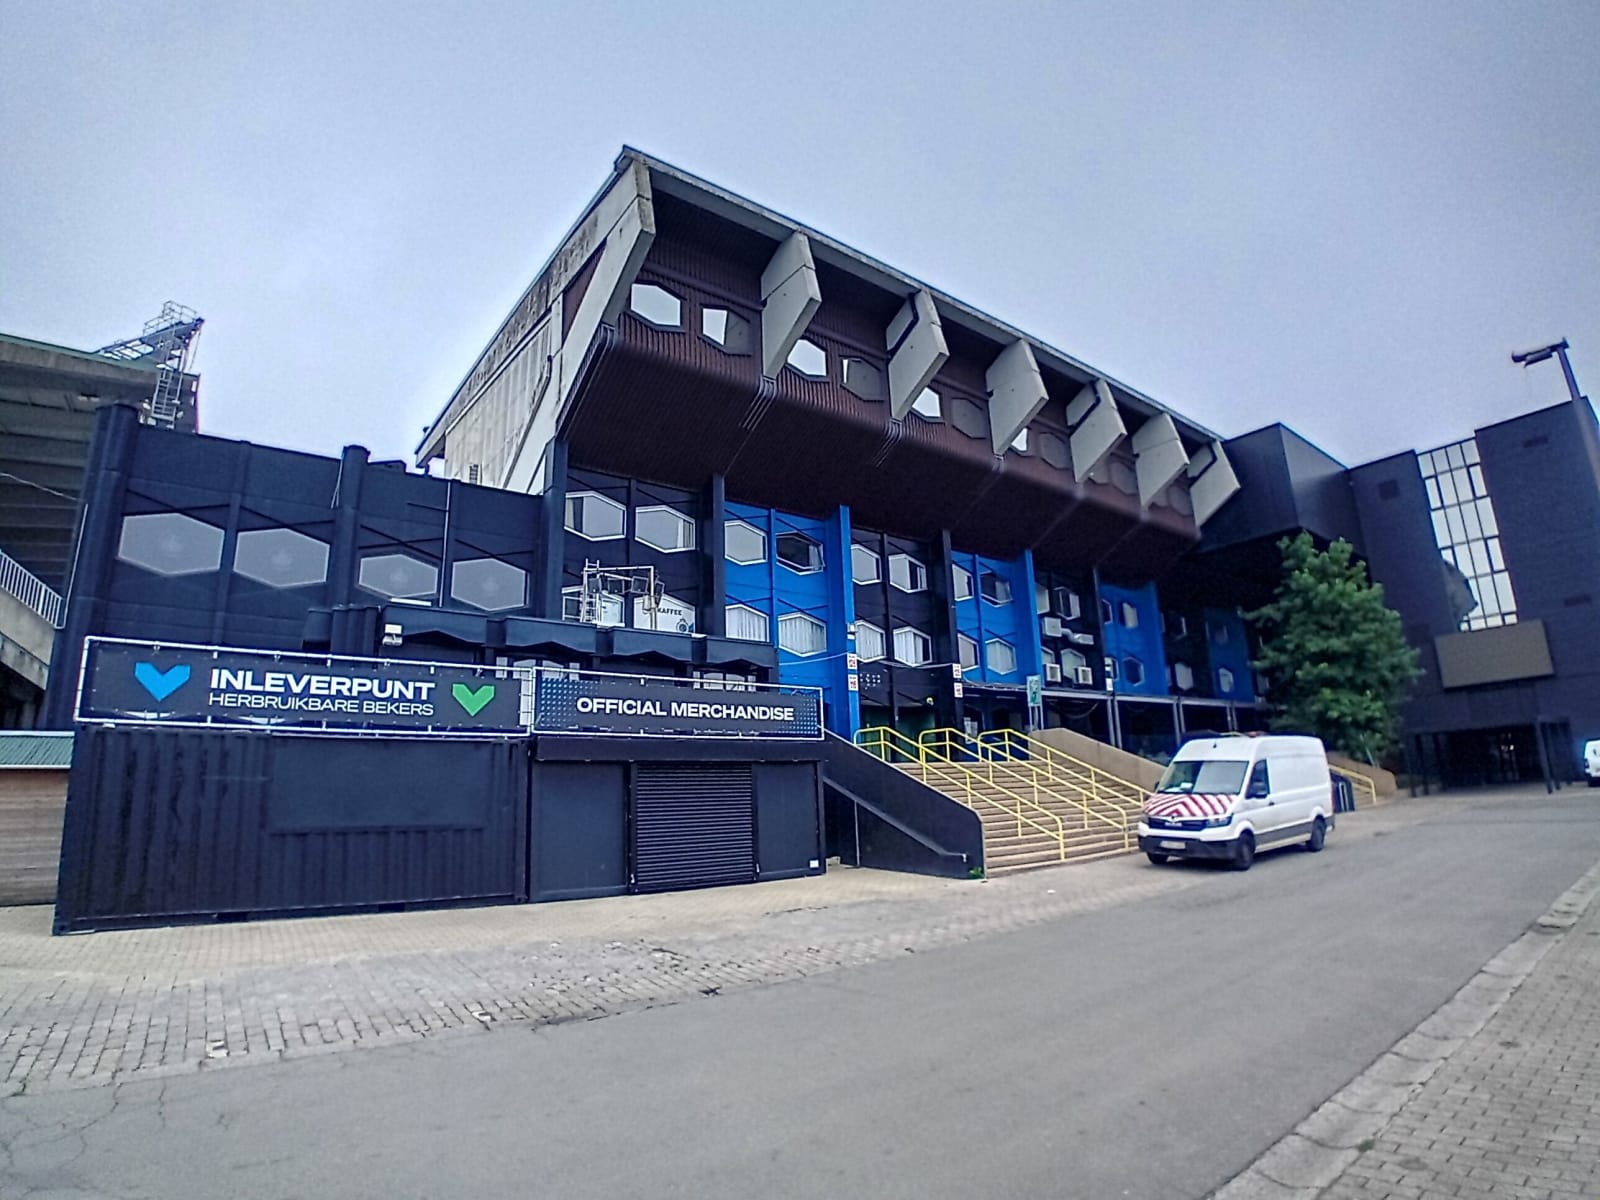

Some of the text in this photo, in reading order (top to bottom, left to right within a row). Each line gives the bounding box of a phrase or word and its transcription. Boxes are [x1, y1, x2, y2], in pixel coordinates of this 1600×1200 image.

[210, 668, 435, 700] INLEVERPUNT
[209, 692, 434, 716] HERBRUIKBARE BEKERS
[576, 697, 795, 721] OFFICIAL MERCHANDISE
